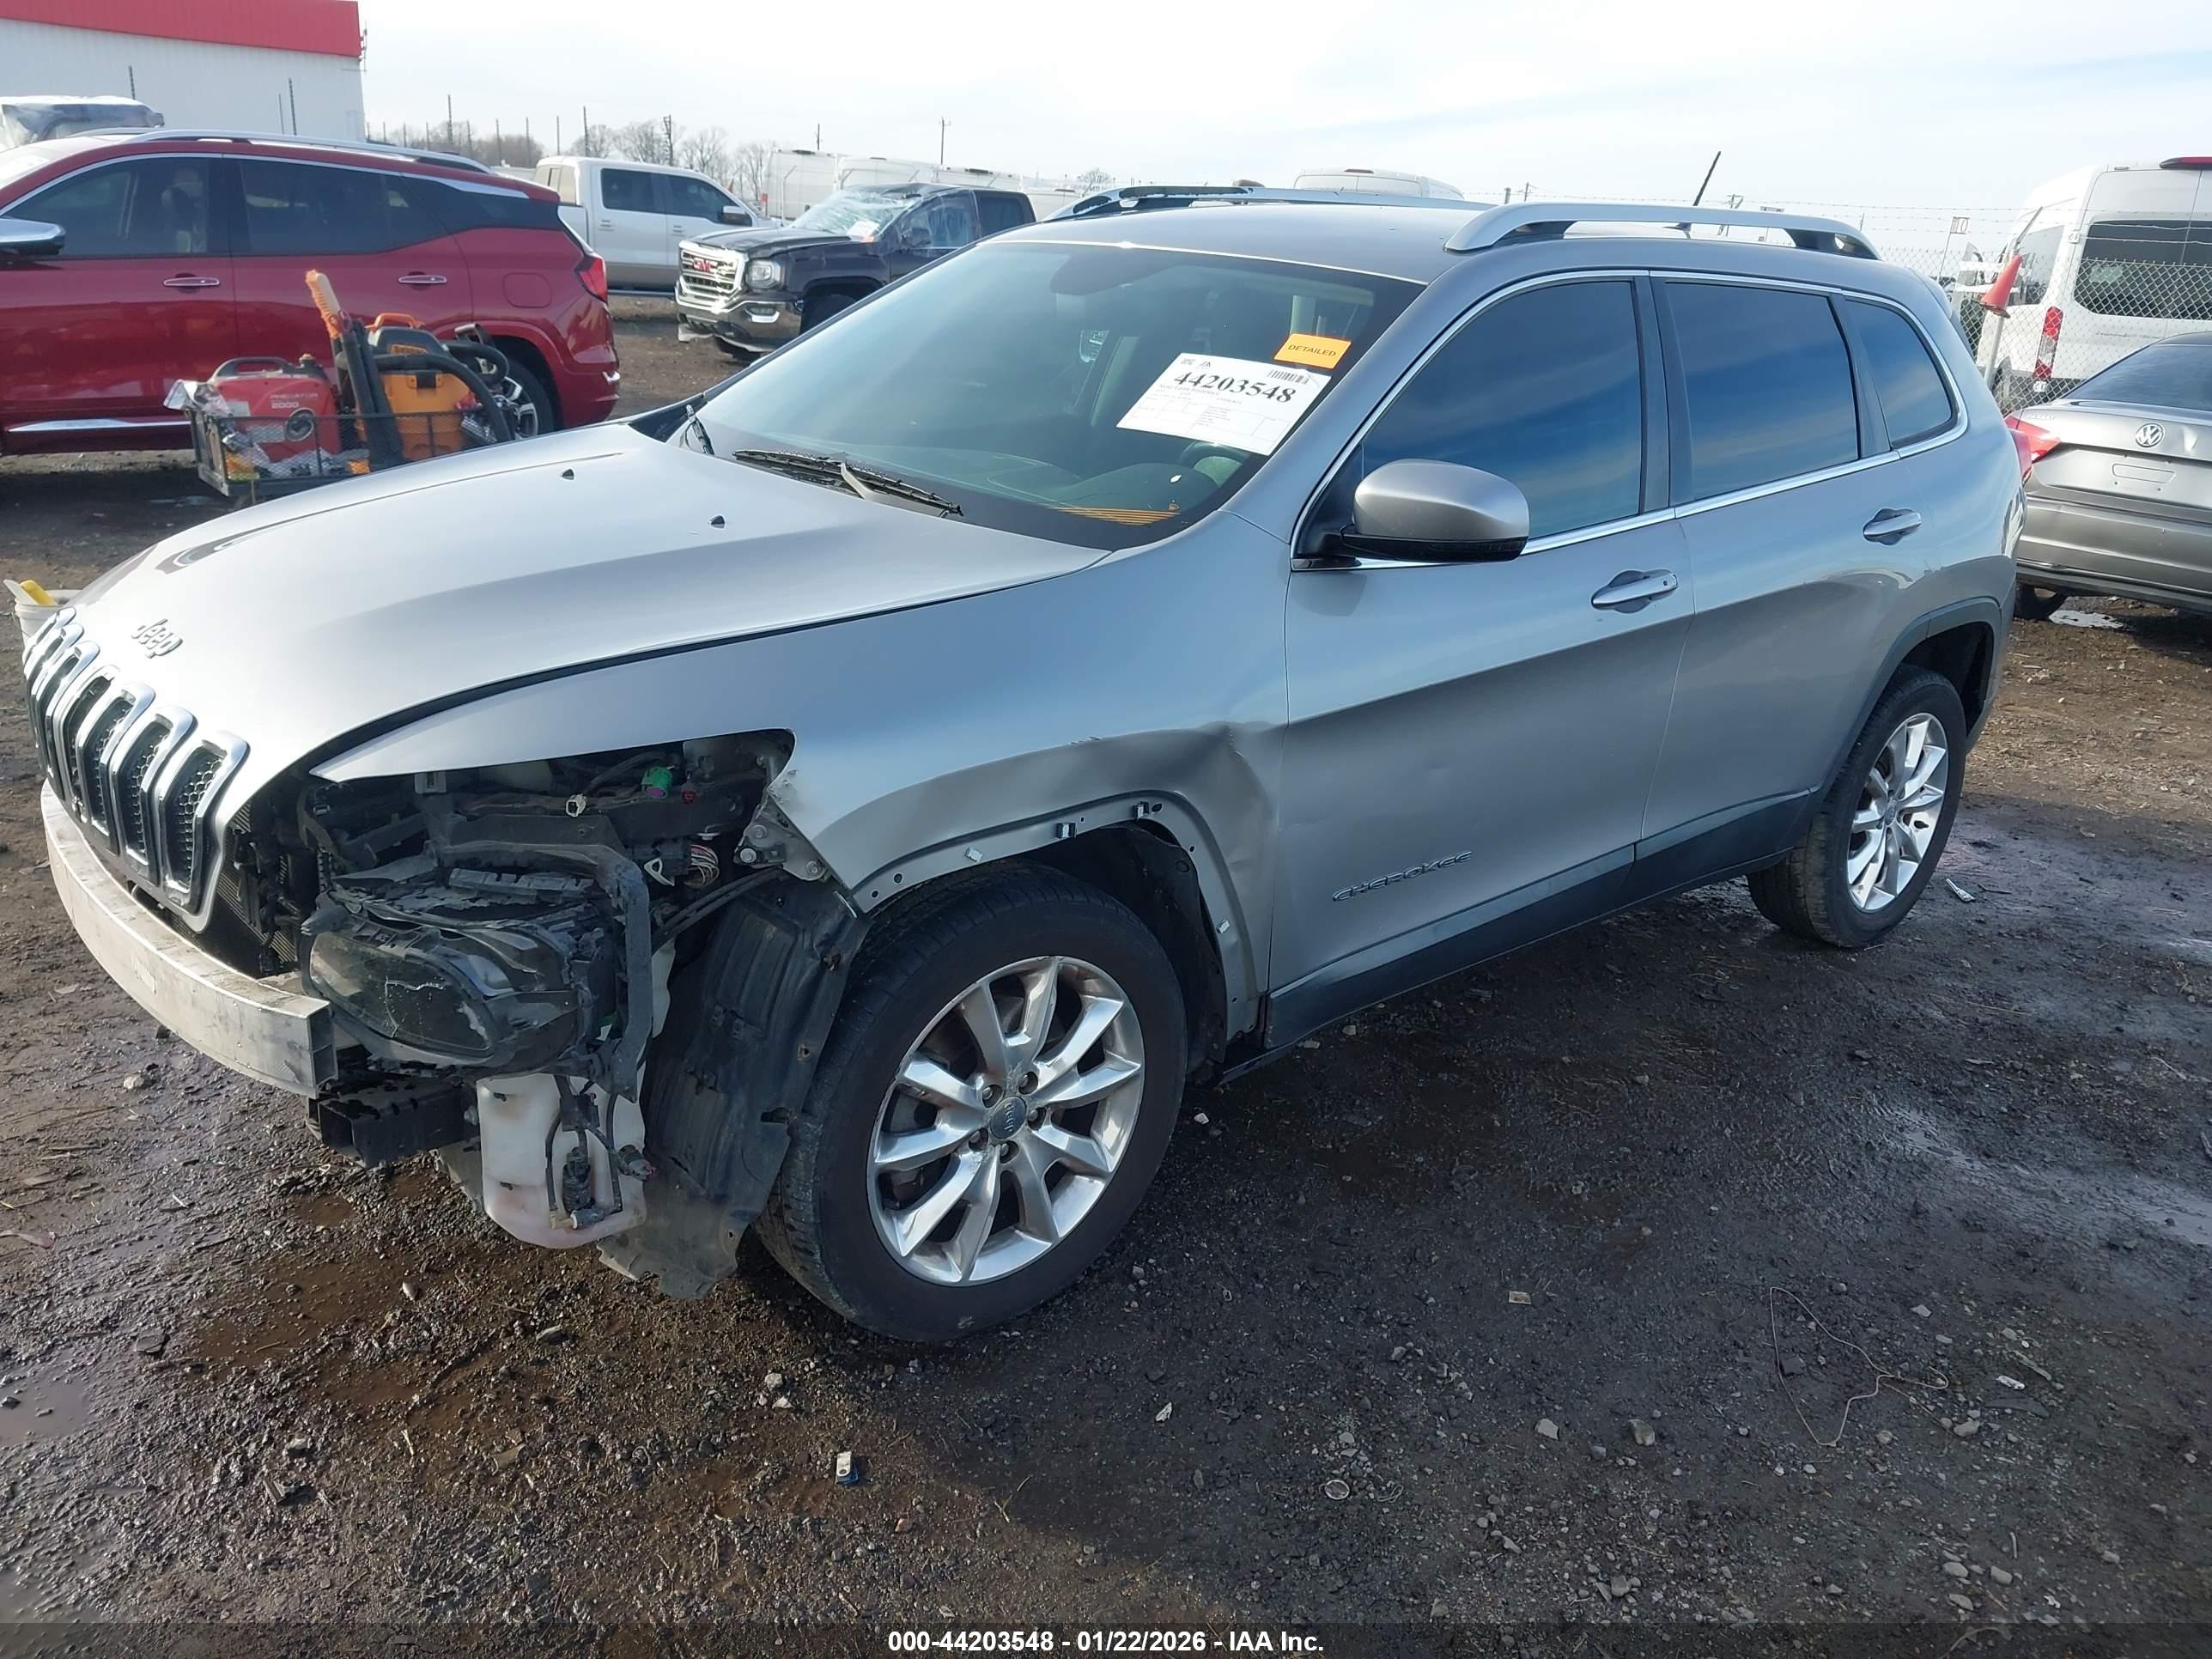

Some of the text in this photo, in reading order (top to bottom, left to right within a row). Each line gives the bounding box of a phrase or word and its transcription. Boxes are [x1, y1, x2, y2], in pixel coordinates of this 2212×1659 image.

[694, 258, 718, 274] GMC
[1288, 344, 1336, 356] DETAILED
[1174, 372, 1296, 403] 44203548
[131, 618, 183, 659] Jeep
[1332, 851, 1472, 901] CHEROKEE
